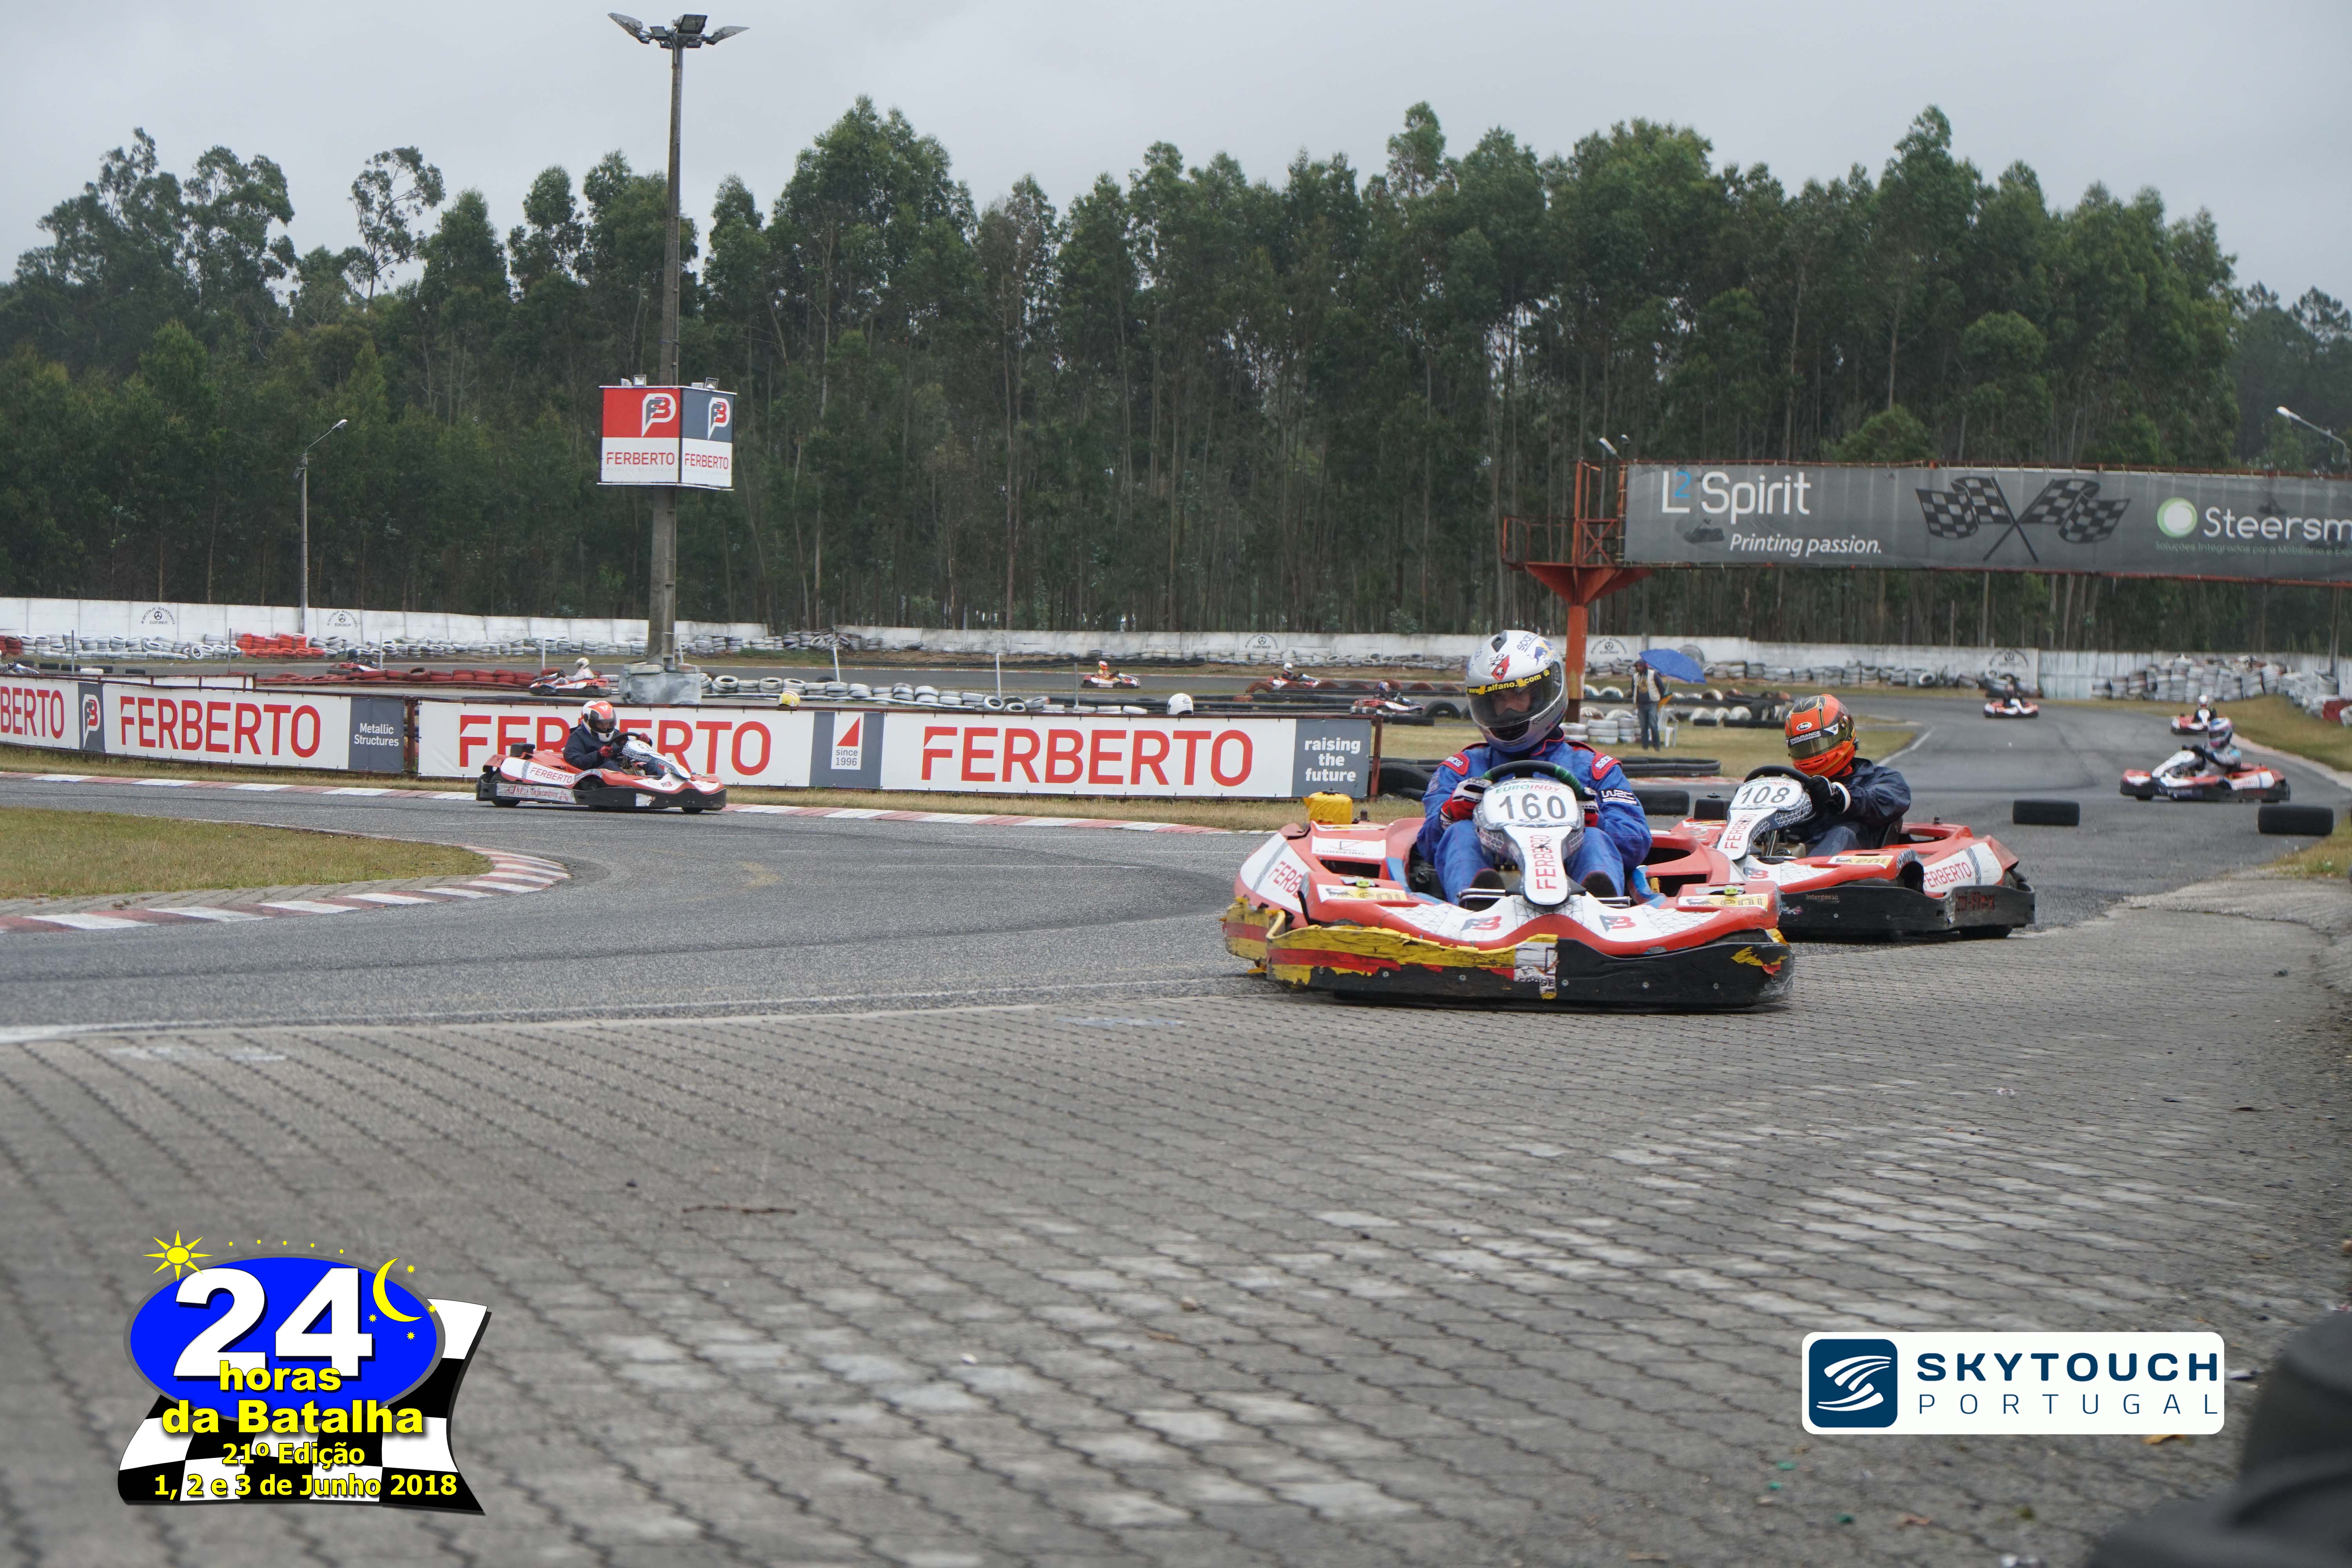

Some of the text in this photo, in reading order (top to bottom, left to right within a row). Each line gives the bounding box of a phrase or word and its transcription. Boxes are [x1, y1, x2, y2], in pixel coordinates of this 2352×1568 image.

[606, 452, 675, 465] FERBERTO
[684, 453, 729, 470] FERBERTO
[1701, 471, 1811, 525] Spirit
[1730, 533, 1882, 558] Printing passion.
[142, 607, 155, 624] ESCOLA
[0, 686, 64, 739] BERTO
[120, 696, 321, 757] FERBERTO
[359, 722, 394, 735] Metallic
[354, 733, 399, 747] Structures
[1790, 730, 1821, 742] ENDURANCE
[1791, 733, 1822, 746] CHAMPIONSHIP
[460, 715, 771, 775] FERRTO
[836, 748, 858, 757] since
[1305, 737, 1361, 755] raising
[835, 757, 857, 766] 1996
[922, 726, 1253, 787] FERBERTO
[1318, 753, 1345, 766] the
[530, 767, 572, 783] FERBERTO
[1305, 768, 1356, 782] future
[1495, 784, 1561, 794] EUROINDY
[1740, 786, 1790, 804] 108
[1499, 793, 1566, 820] 160
[1724, 813, 1757, 849] FERBERTO
[1530, 835, 1557, 889] FERBERTO
[1268, 860, 1303, 899] FERB
[1720, 898, 1762, 906] eni
